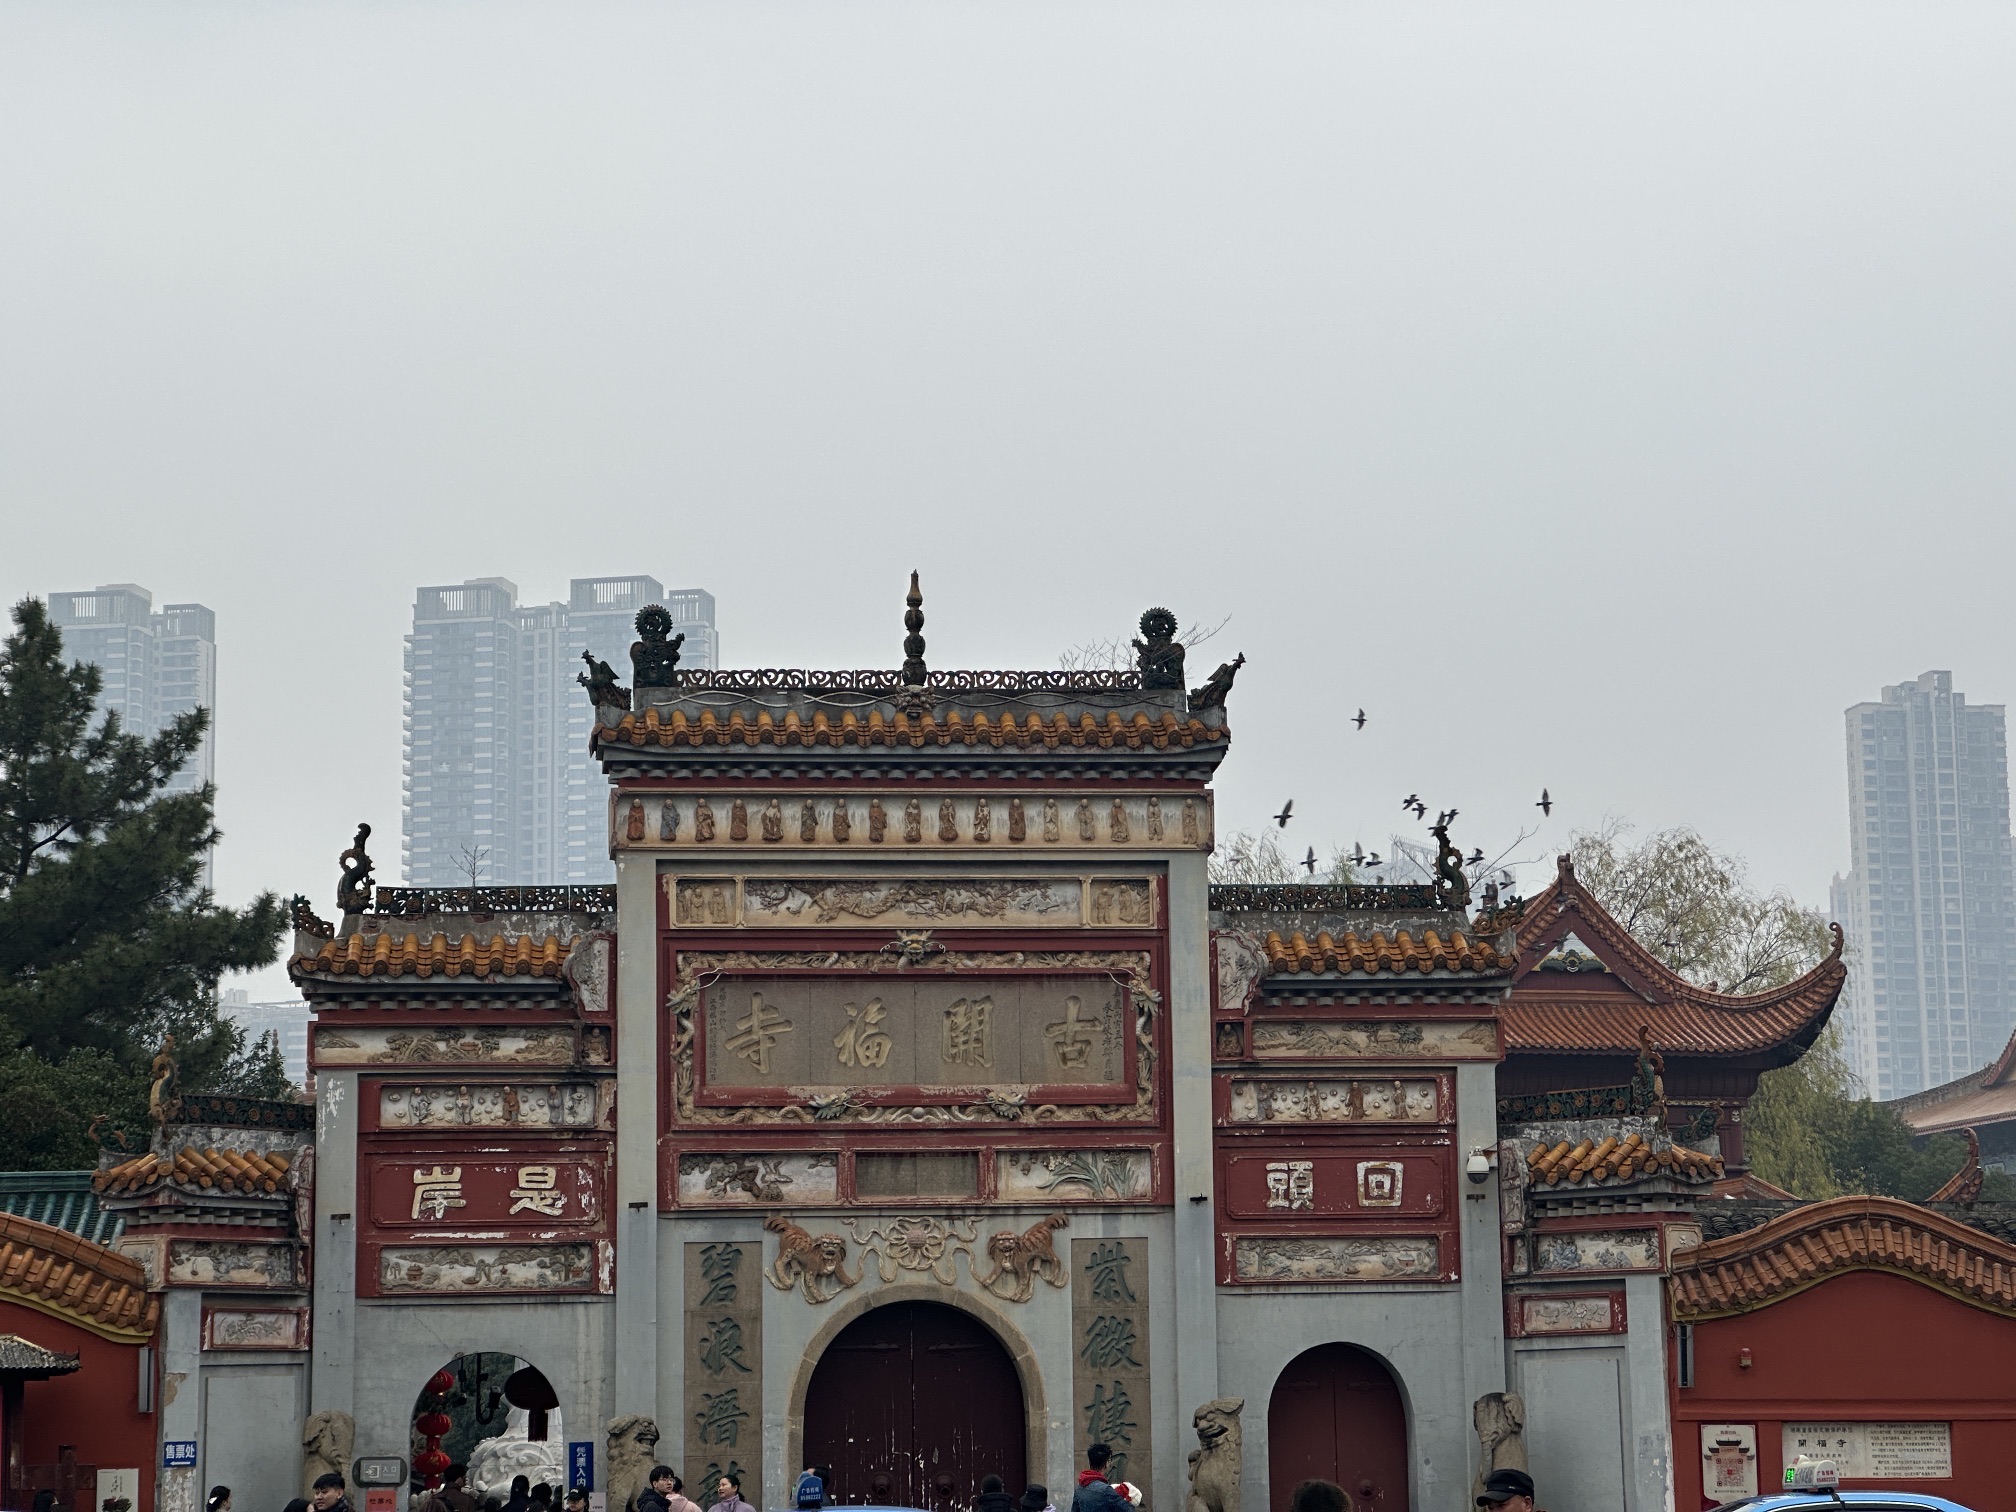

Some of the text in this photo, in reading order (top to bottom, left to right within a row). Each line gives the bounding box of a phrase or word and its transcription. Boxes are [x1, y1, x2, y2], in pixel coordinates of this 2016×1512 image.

[724, 991, 1104, 1074] 古開福寺
[411, 1166, 563, 1220] 是岸
[1265, 1161, 1404, 1210] 回頭
[165, 1444, 196, 1459] 售票处
[576, 1446, 587, 1487] 凭票入内
